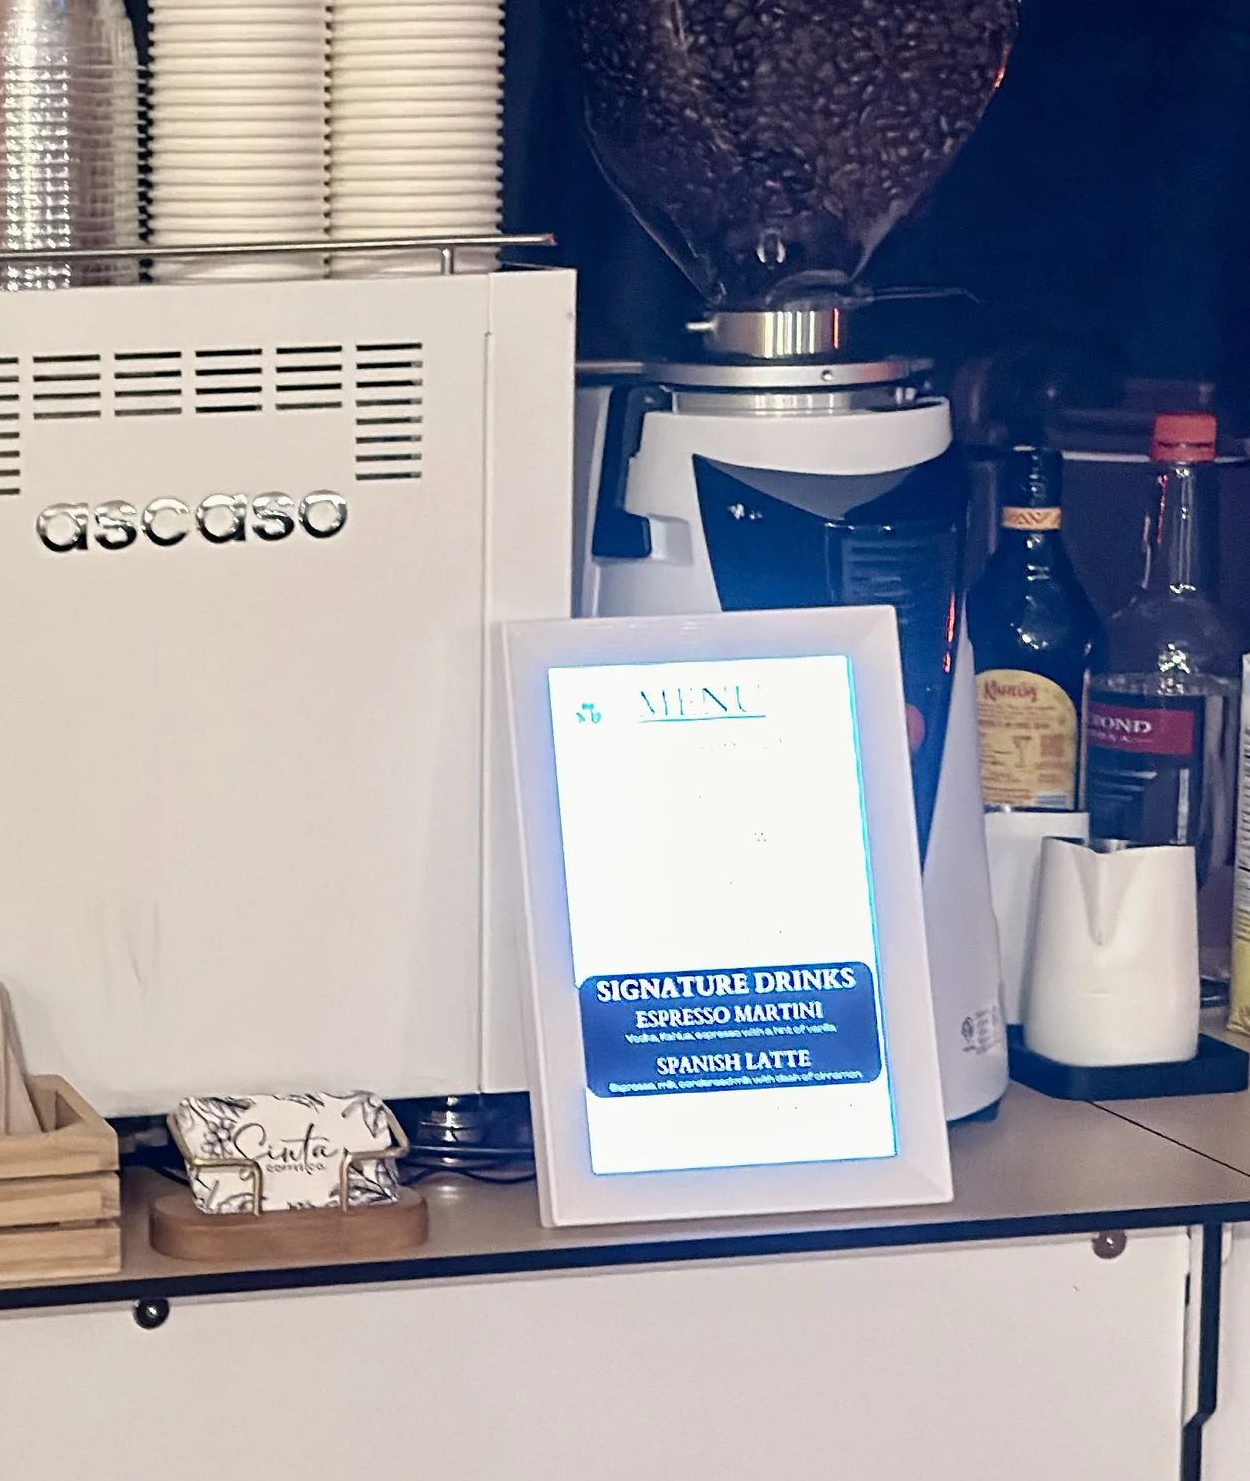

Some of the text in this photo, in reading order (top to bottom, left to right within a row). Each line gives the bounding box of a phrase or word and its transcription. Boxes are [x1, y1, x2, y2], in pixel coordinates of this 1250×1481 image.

[35, 488, 349, 554] ascaso
[596, 967, 858, 1003] SIGNATURE DRINKS
[635, 1001, 825, 1029] ESPRESSO MARTINI
[656, 1049, 813, 1076] SPANISH LATTE
[233, 1122, 339, 1181] Sinta
